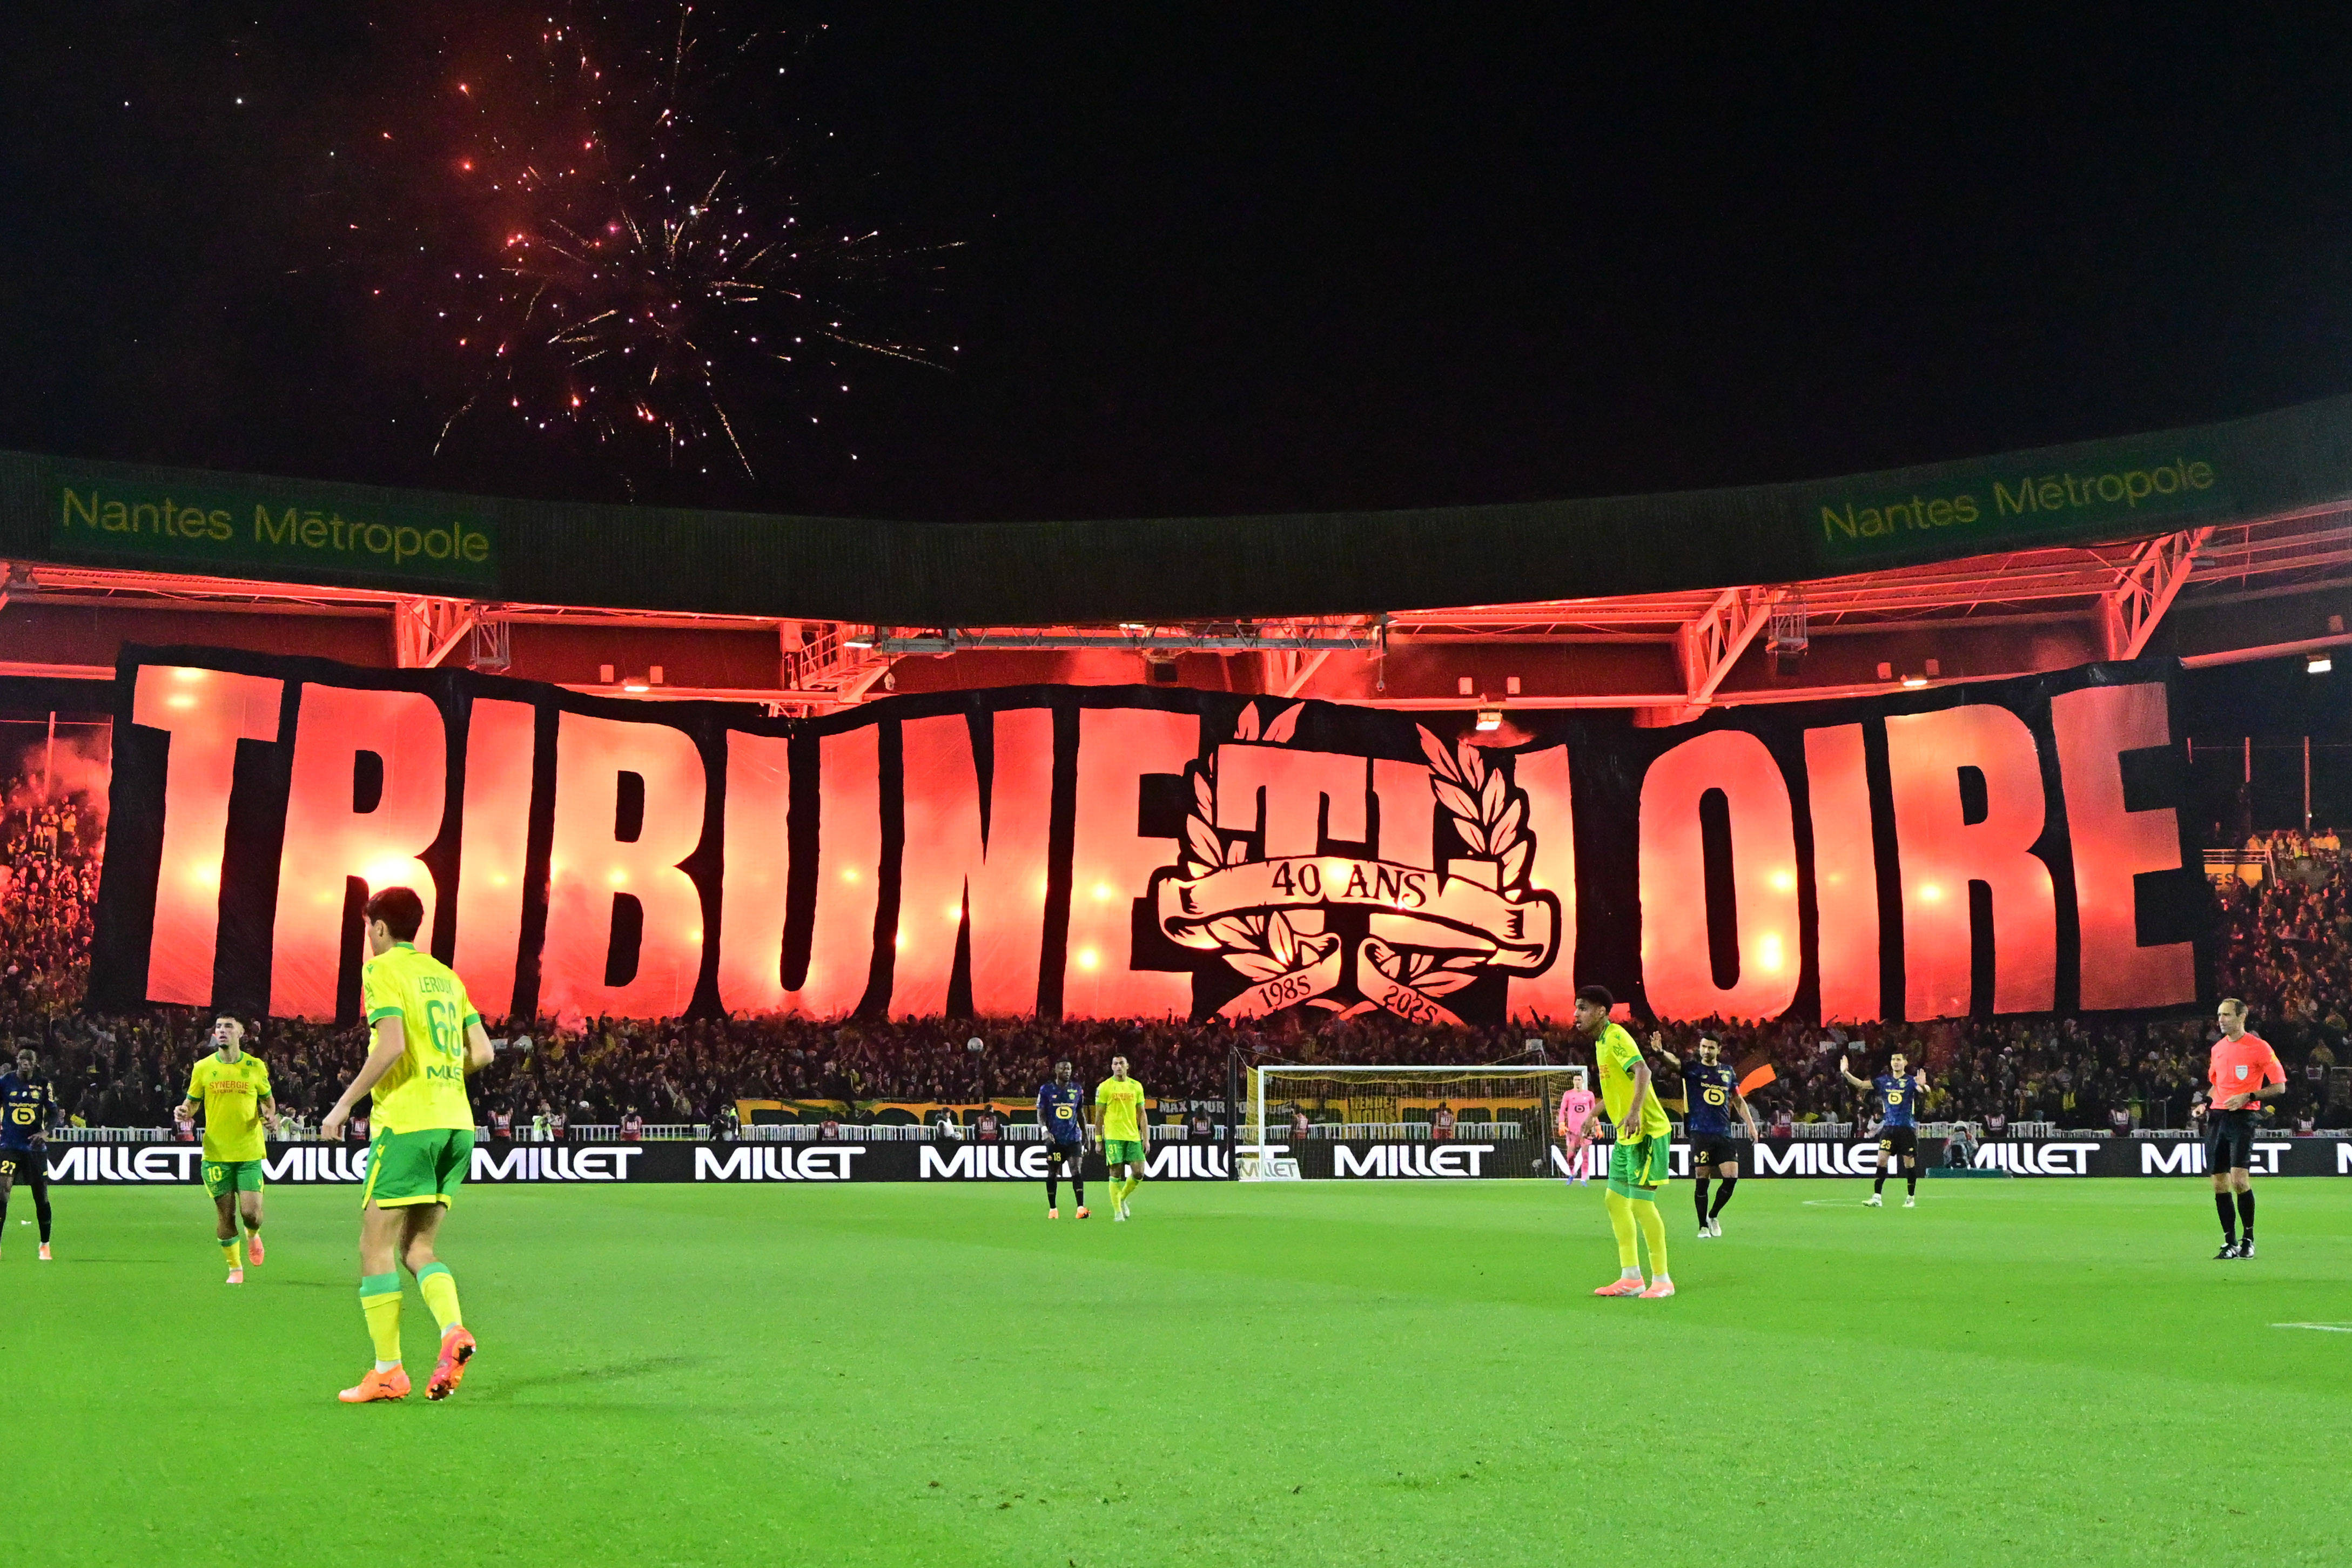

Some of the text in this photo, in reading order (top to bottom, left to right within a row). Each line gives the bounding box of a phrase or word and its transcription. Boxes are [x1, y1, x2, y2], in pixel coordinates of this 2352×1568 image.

[62, 487, 233, 540] Nantes
[1821, 491, 1979, 541] Nantes
[133, 664, 2197, 1027] TRIBUNE LOIRE
[1272, 862, 1426, 909] 40 ANS
[418, 976, 454, 995] LEROUX
[1259, 975, 1311, 1009] 1985
[1382, 985, 1438, 1024] 2025
[426, 1000, 461, 1057] 66
[209, 1080, 249, 1089] SYNERGIE
[1159, 1100, 1187, 1113] MAX
[1052, 1152, 1061, 1162] 18
[1108, 1143, 1118, 1154] 31
[1700, 1151, 1709, 1163] 2
[1753, 1143, 1897, 1175] MILLE
[1880, 1139, 1892, 1150] 23
[0, 1160, 16, 1175] 27
[207, 1166, 223, 1182] 10
[471, 1147, 642, 1180] MILLET
[695, 1146, 866, 1180] MILLET
[920, 1145, 1072, 1178] MILLE
[1334, 1145, 1495, 1177] MILLET
